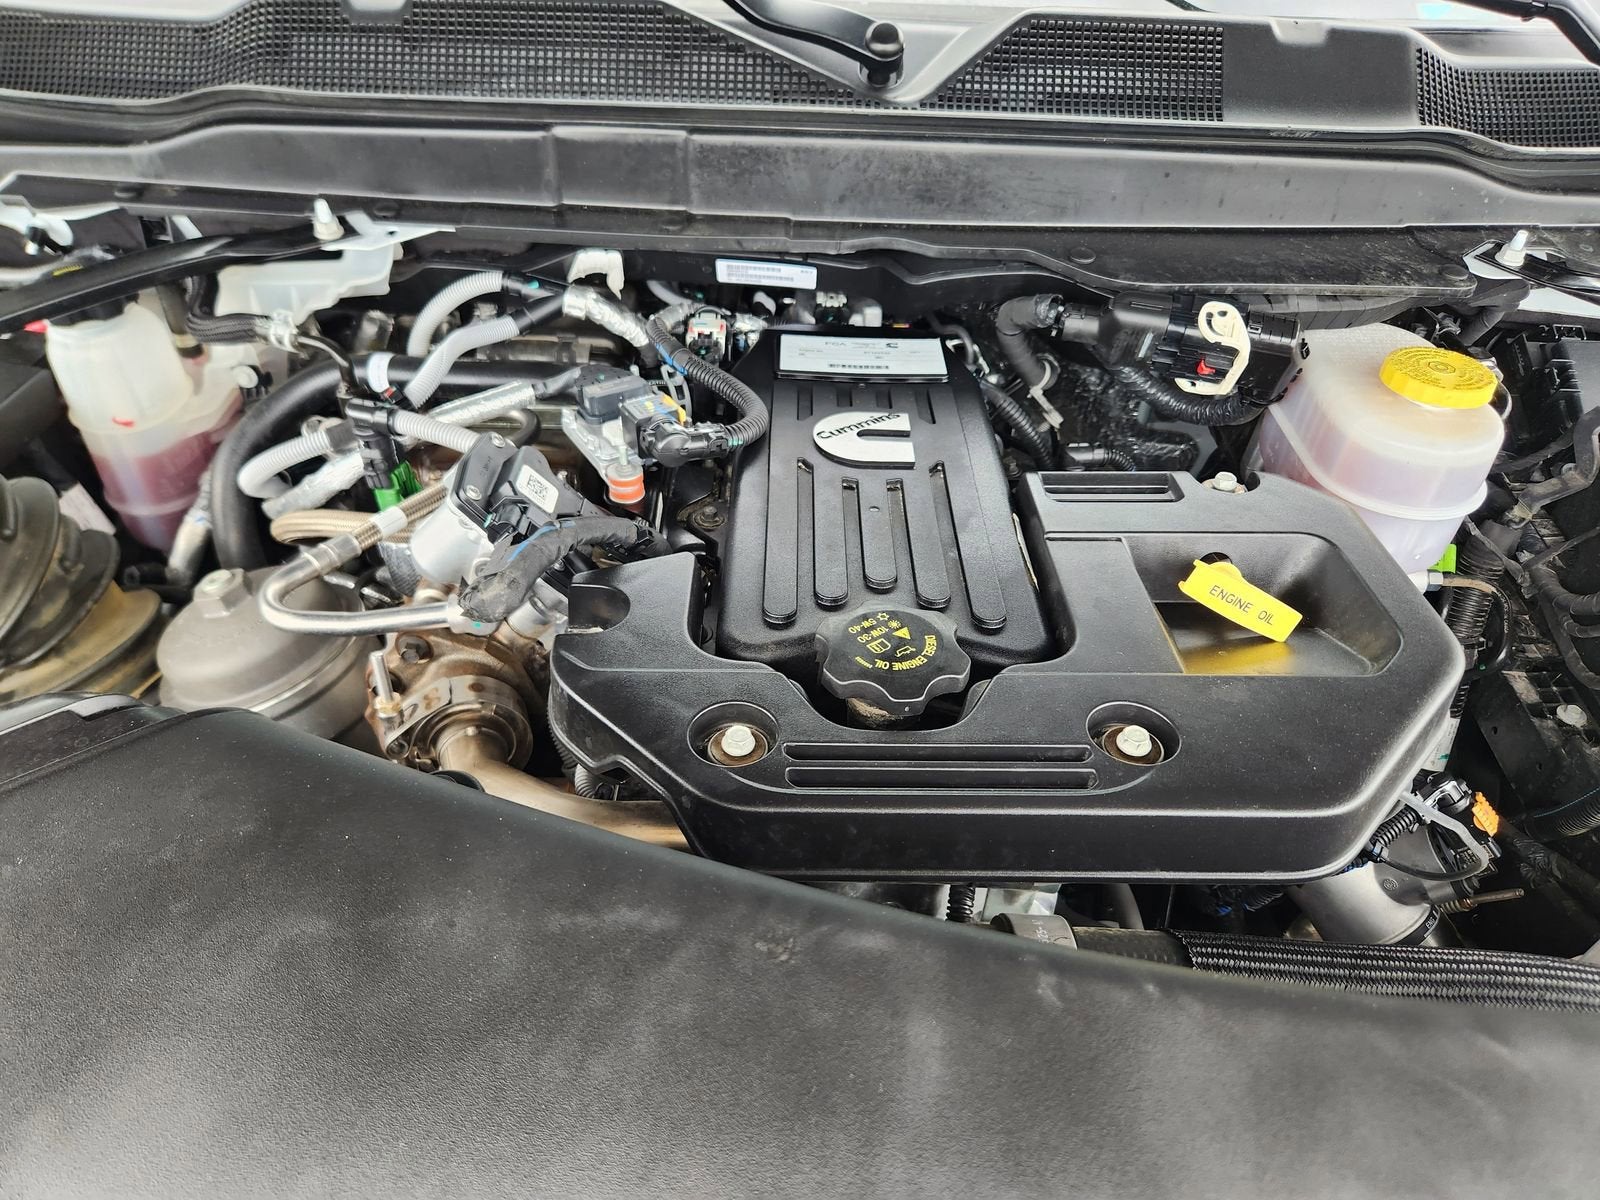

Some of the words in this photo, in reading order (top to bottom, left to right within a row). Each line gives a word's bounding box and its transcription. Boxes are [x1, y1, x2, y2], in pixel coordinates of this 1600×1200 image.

[816, 412, 901, 440] Cummins
[1209, 584, 1254, 613] ENGINE
[1257, 610, 1274, 626] OIL
[848, 618, 877, 634] 5W-40
[857, 625, 889, 643] 10W-30
[921, 635, 937, 656] DIESEL
[874, 659, 890, 670] OIL
[892, 655, 928, 671] ENGINE
